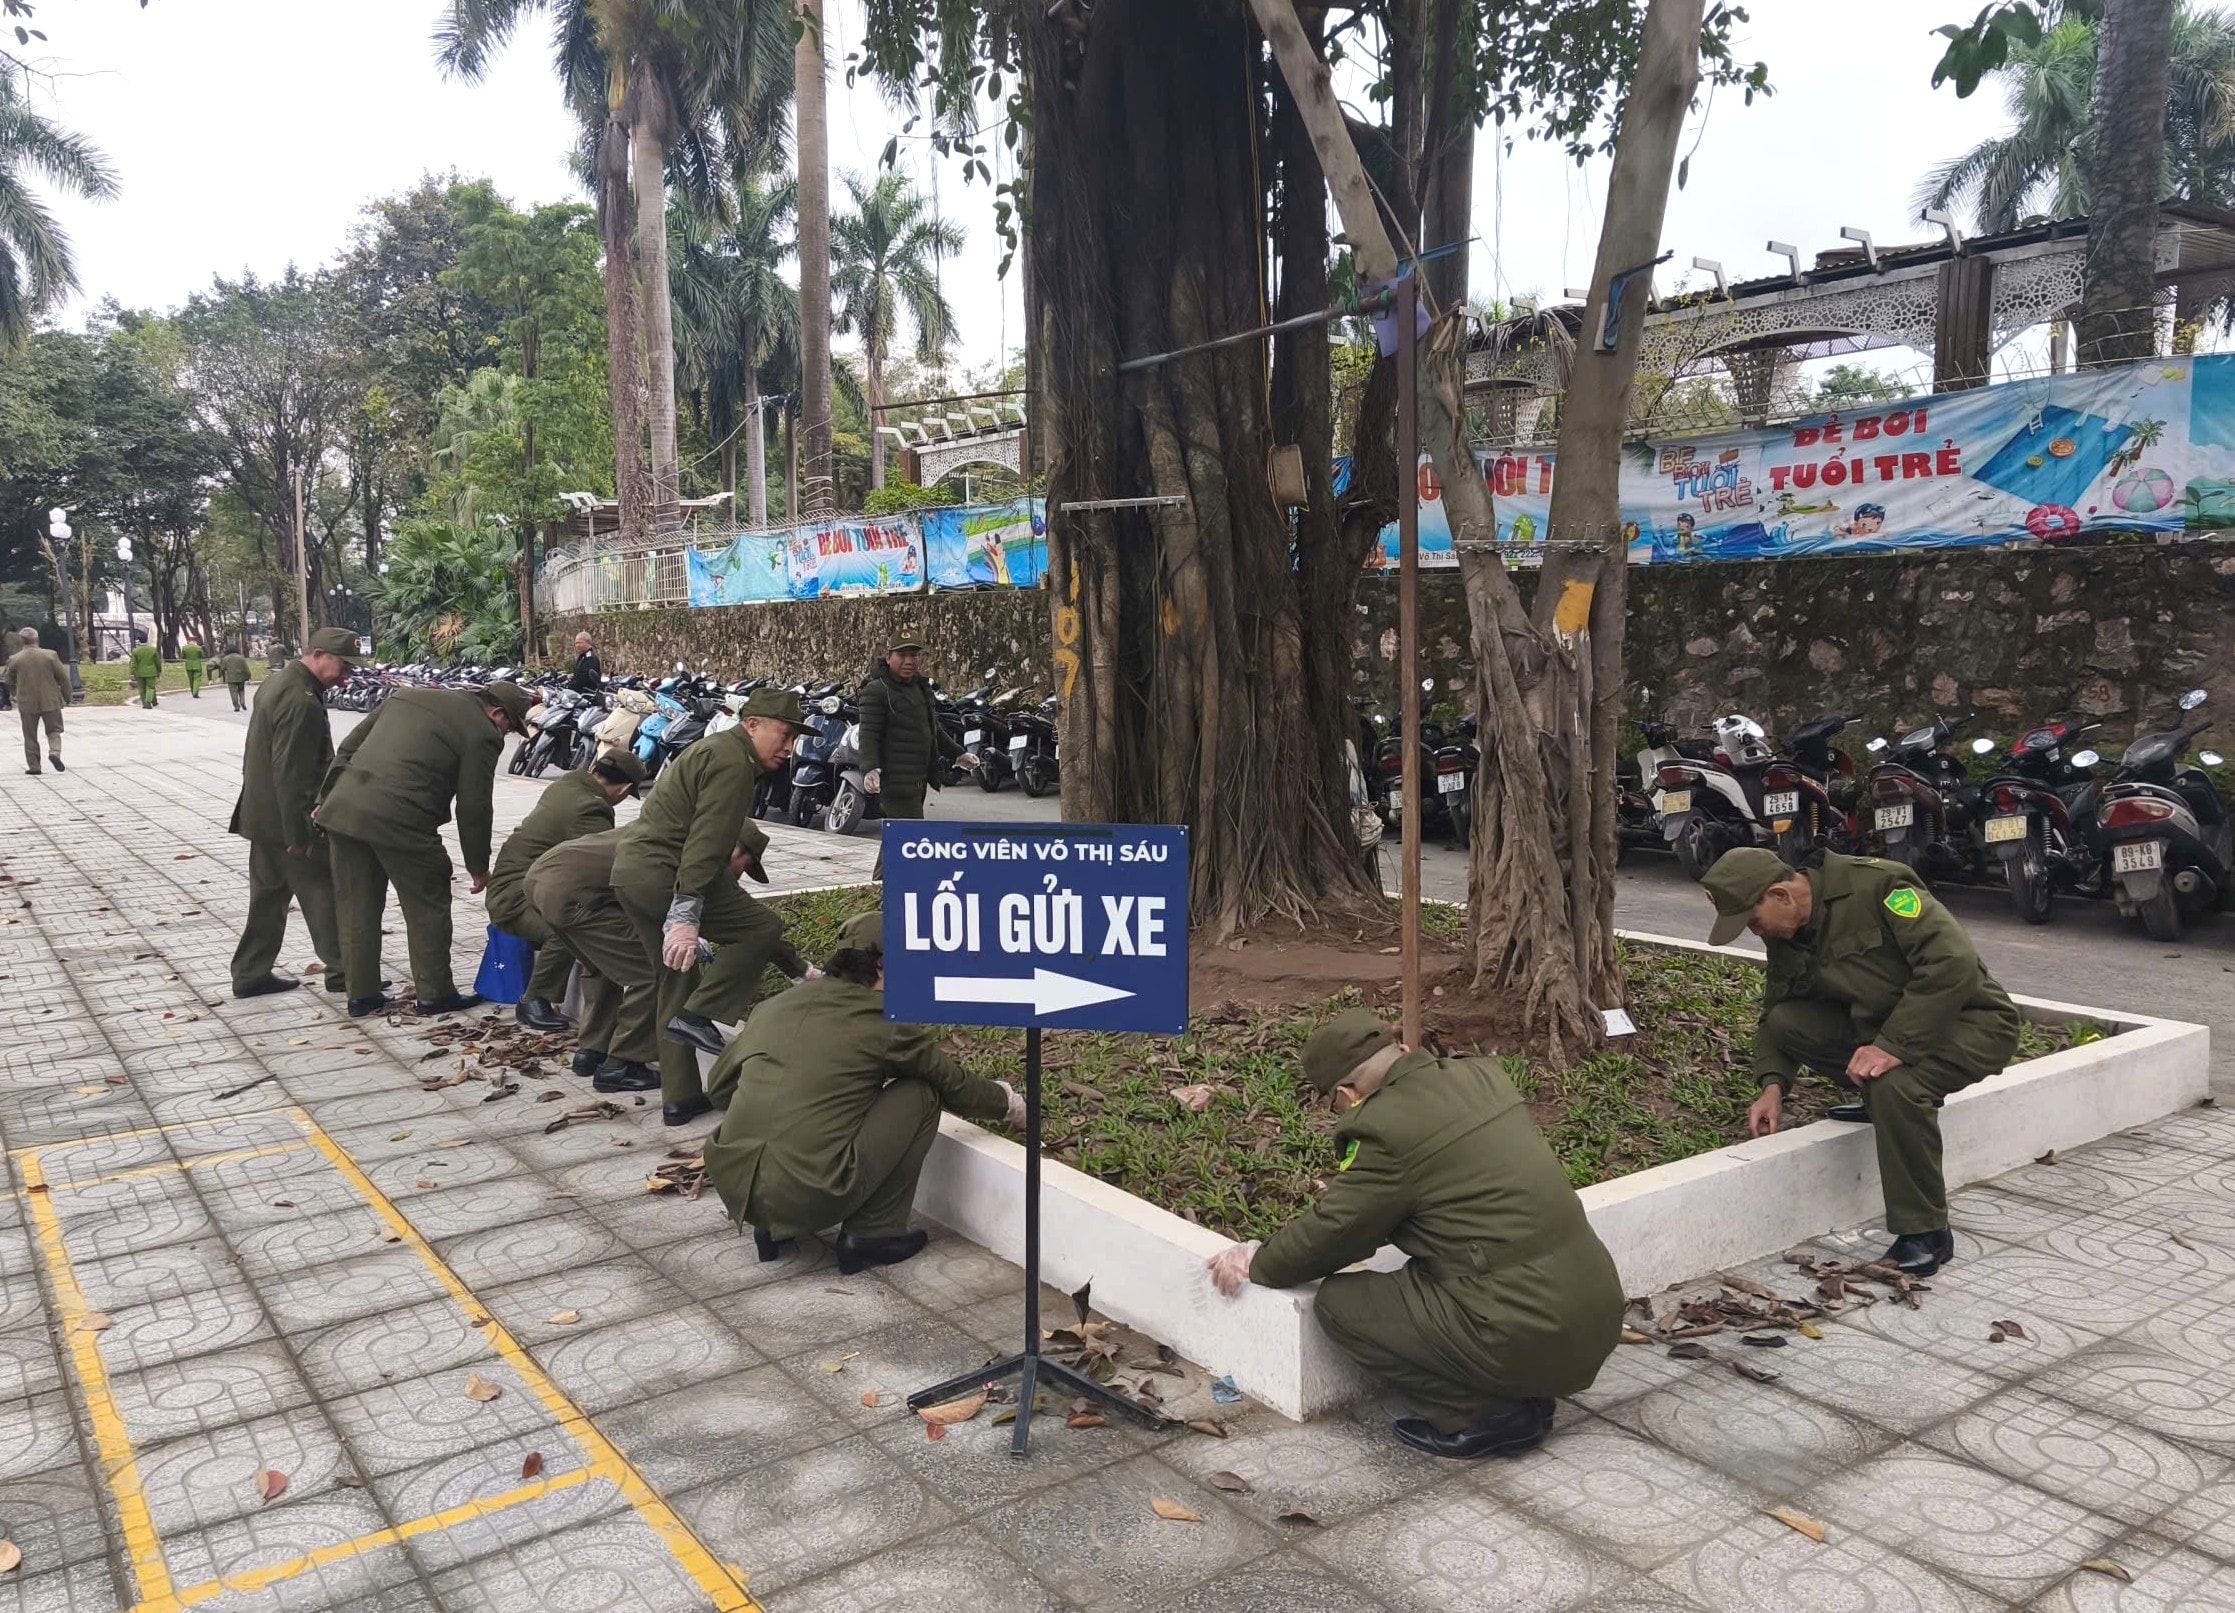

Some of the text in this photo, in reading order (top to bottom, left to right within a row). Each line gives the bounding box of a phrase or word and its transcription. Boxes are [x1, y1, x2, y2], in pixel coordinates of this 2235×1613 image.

[1852, 407, 1929, 441] BƠI
[1769, 438, 1961, 491] TUỔI TRẺ
[1698, 477, 1753, 513] TRẺ
[1769, 802, 1793, 813] 4658
[1881, 815, 1906, 828] 2547
[901, 837, 1168, 866] CÔNG VIÊN VÕ THỊ SÁU
[2122, 855, 2154, 870] 3549
[904, 871, 1167, 957] LỐI GỬI XE
